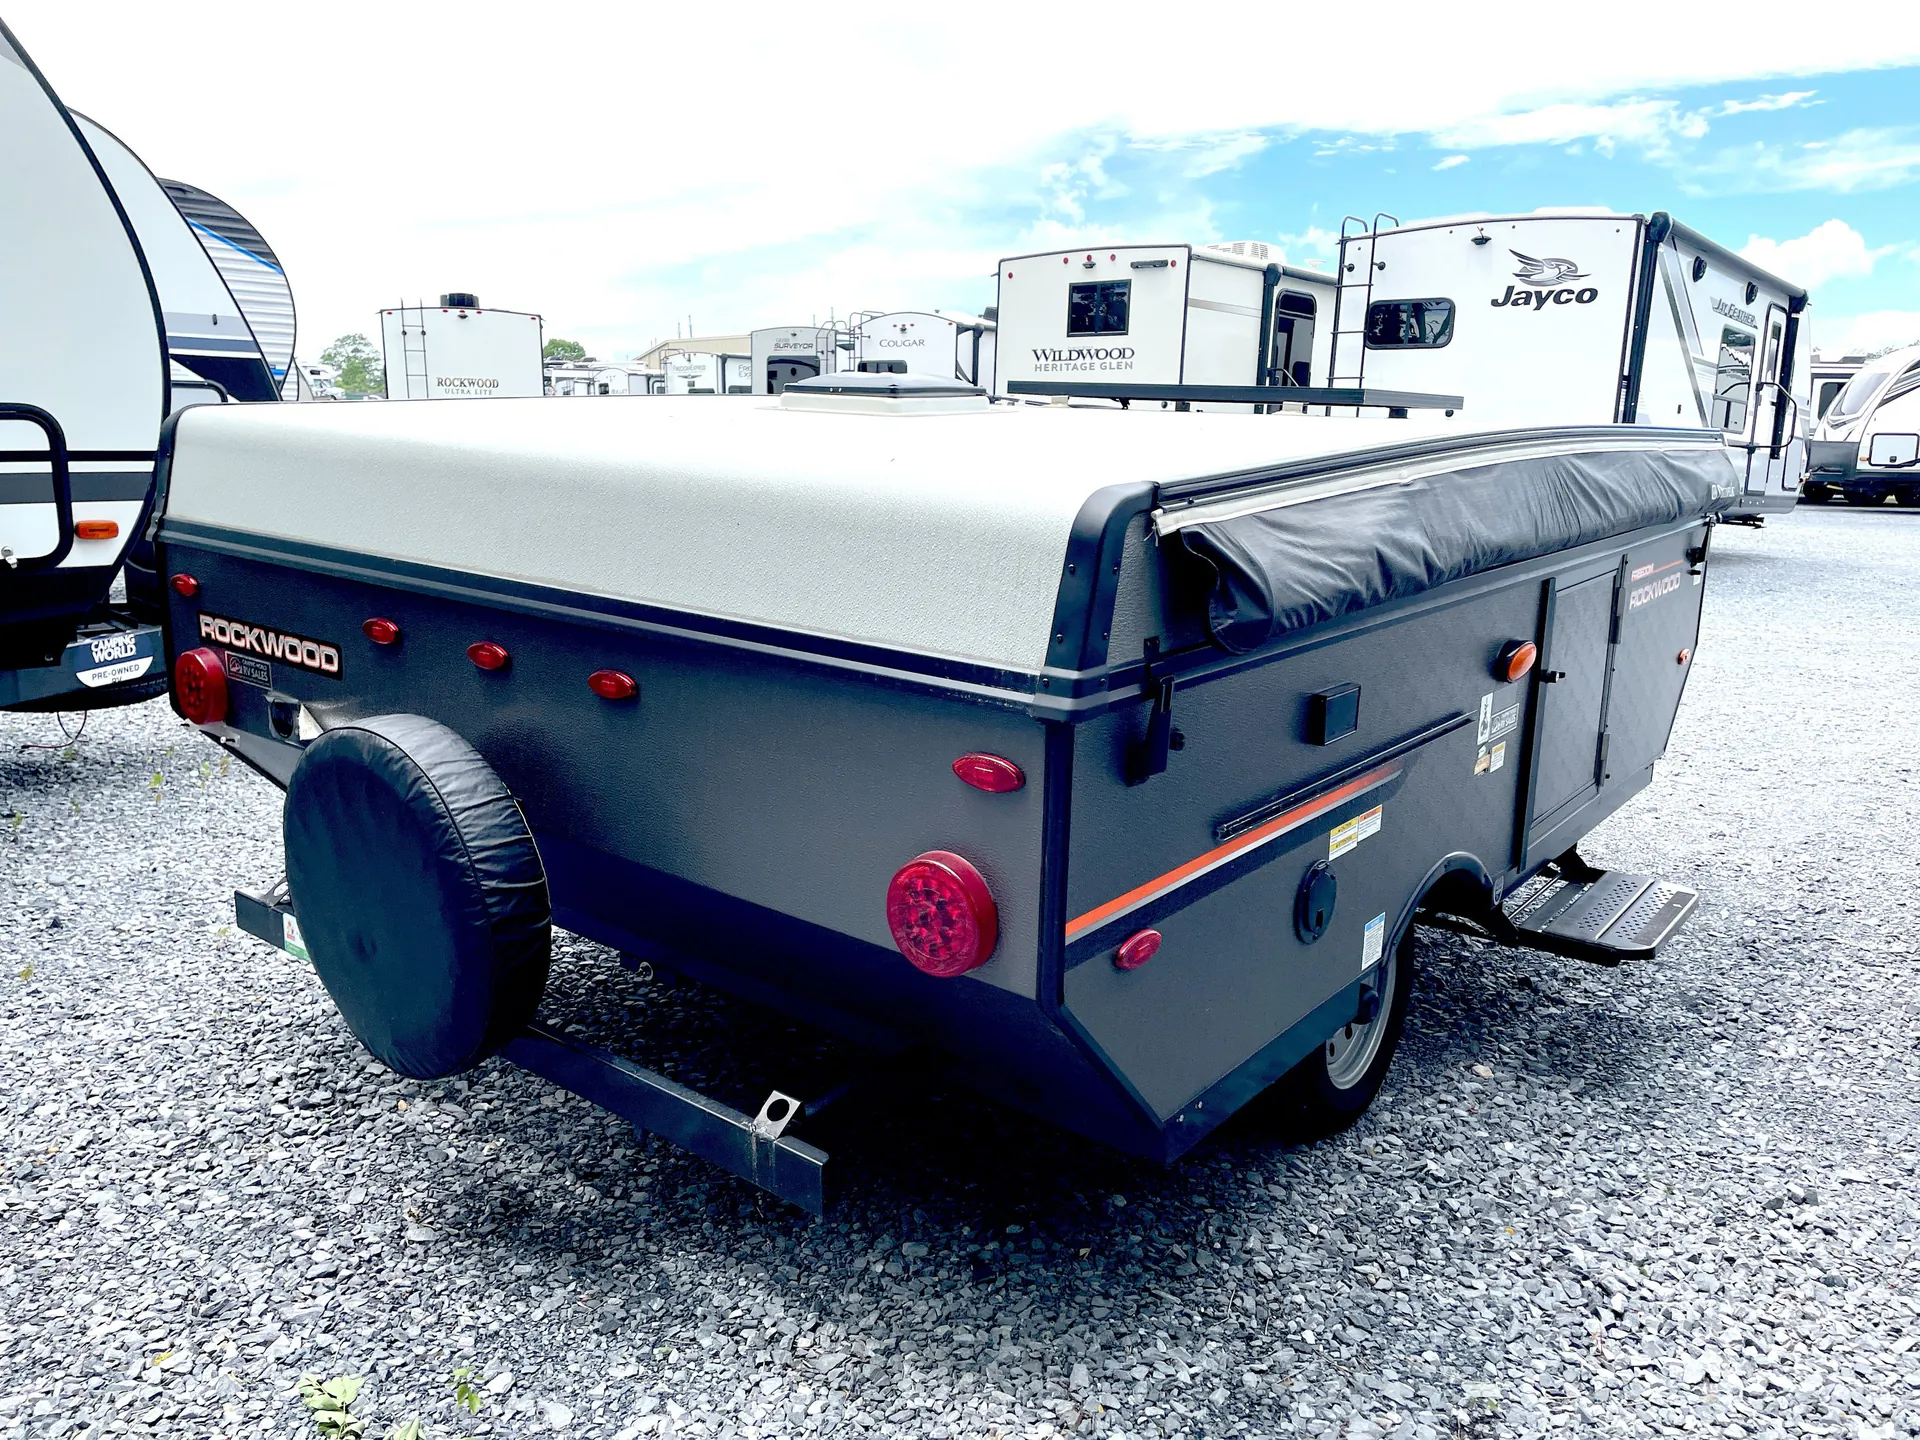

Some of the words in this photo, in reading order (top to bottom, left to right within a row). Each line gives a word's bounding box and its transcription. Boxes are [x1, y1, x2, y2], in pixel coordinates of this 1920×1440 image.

[1490, 285, 1599, 311] Jayco
[774, 342, 814, 350] SURVEYOR
[879, 339, 925, 348] COUGAR
[1032, 347, 1135, 362] WILDWOOD
[1034, 362, 1096, 372] HERITAGE
[1099, 360, 1133, 371] GLEN
[436, 377, 499, 389] ROCKWOOD
[1629, 572, 1681, 610] ROCKWOOD
[91, 634, 136, 652] CAMPING
[199, 614, 339, 673] ROCKWOOD
[92, 644, 136, 664] WORLD
[91, 664, 140, 681] PRE-OWNED
[251, 668, 269, 682] SALES
